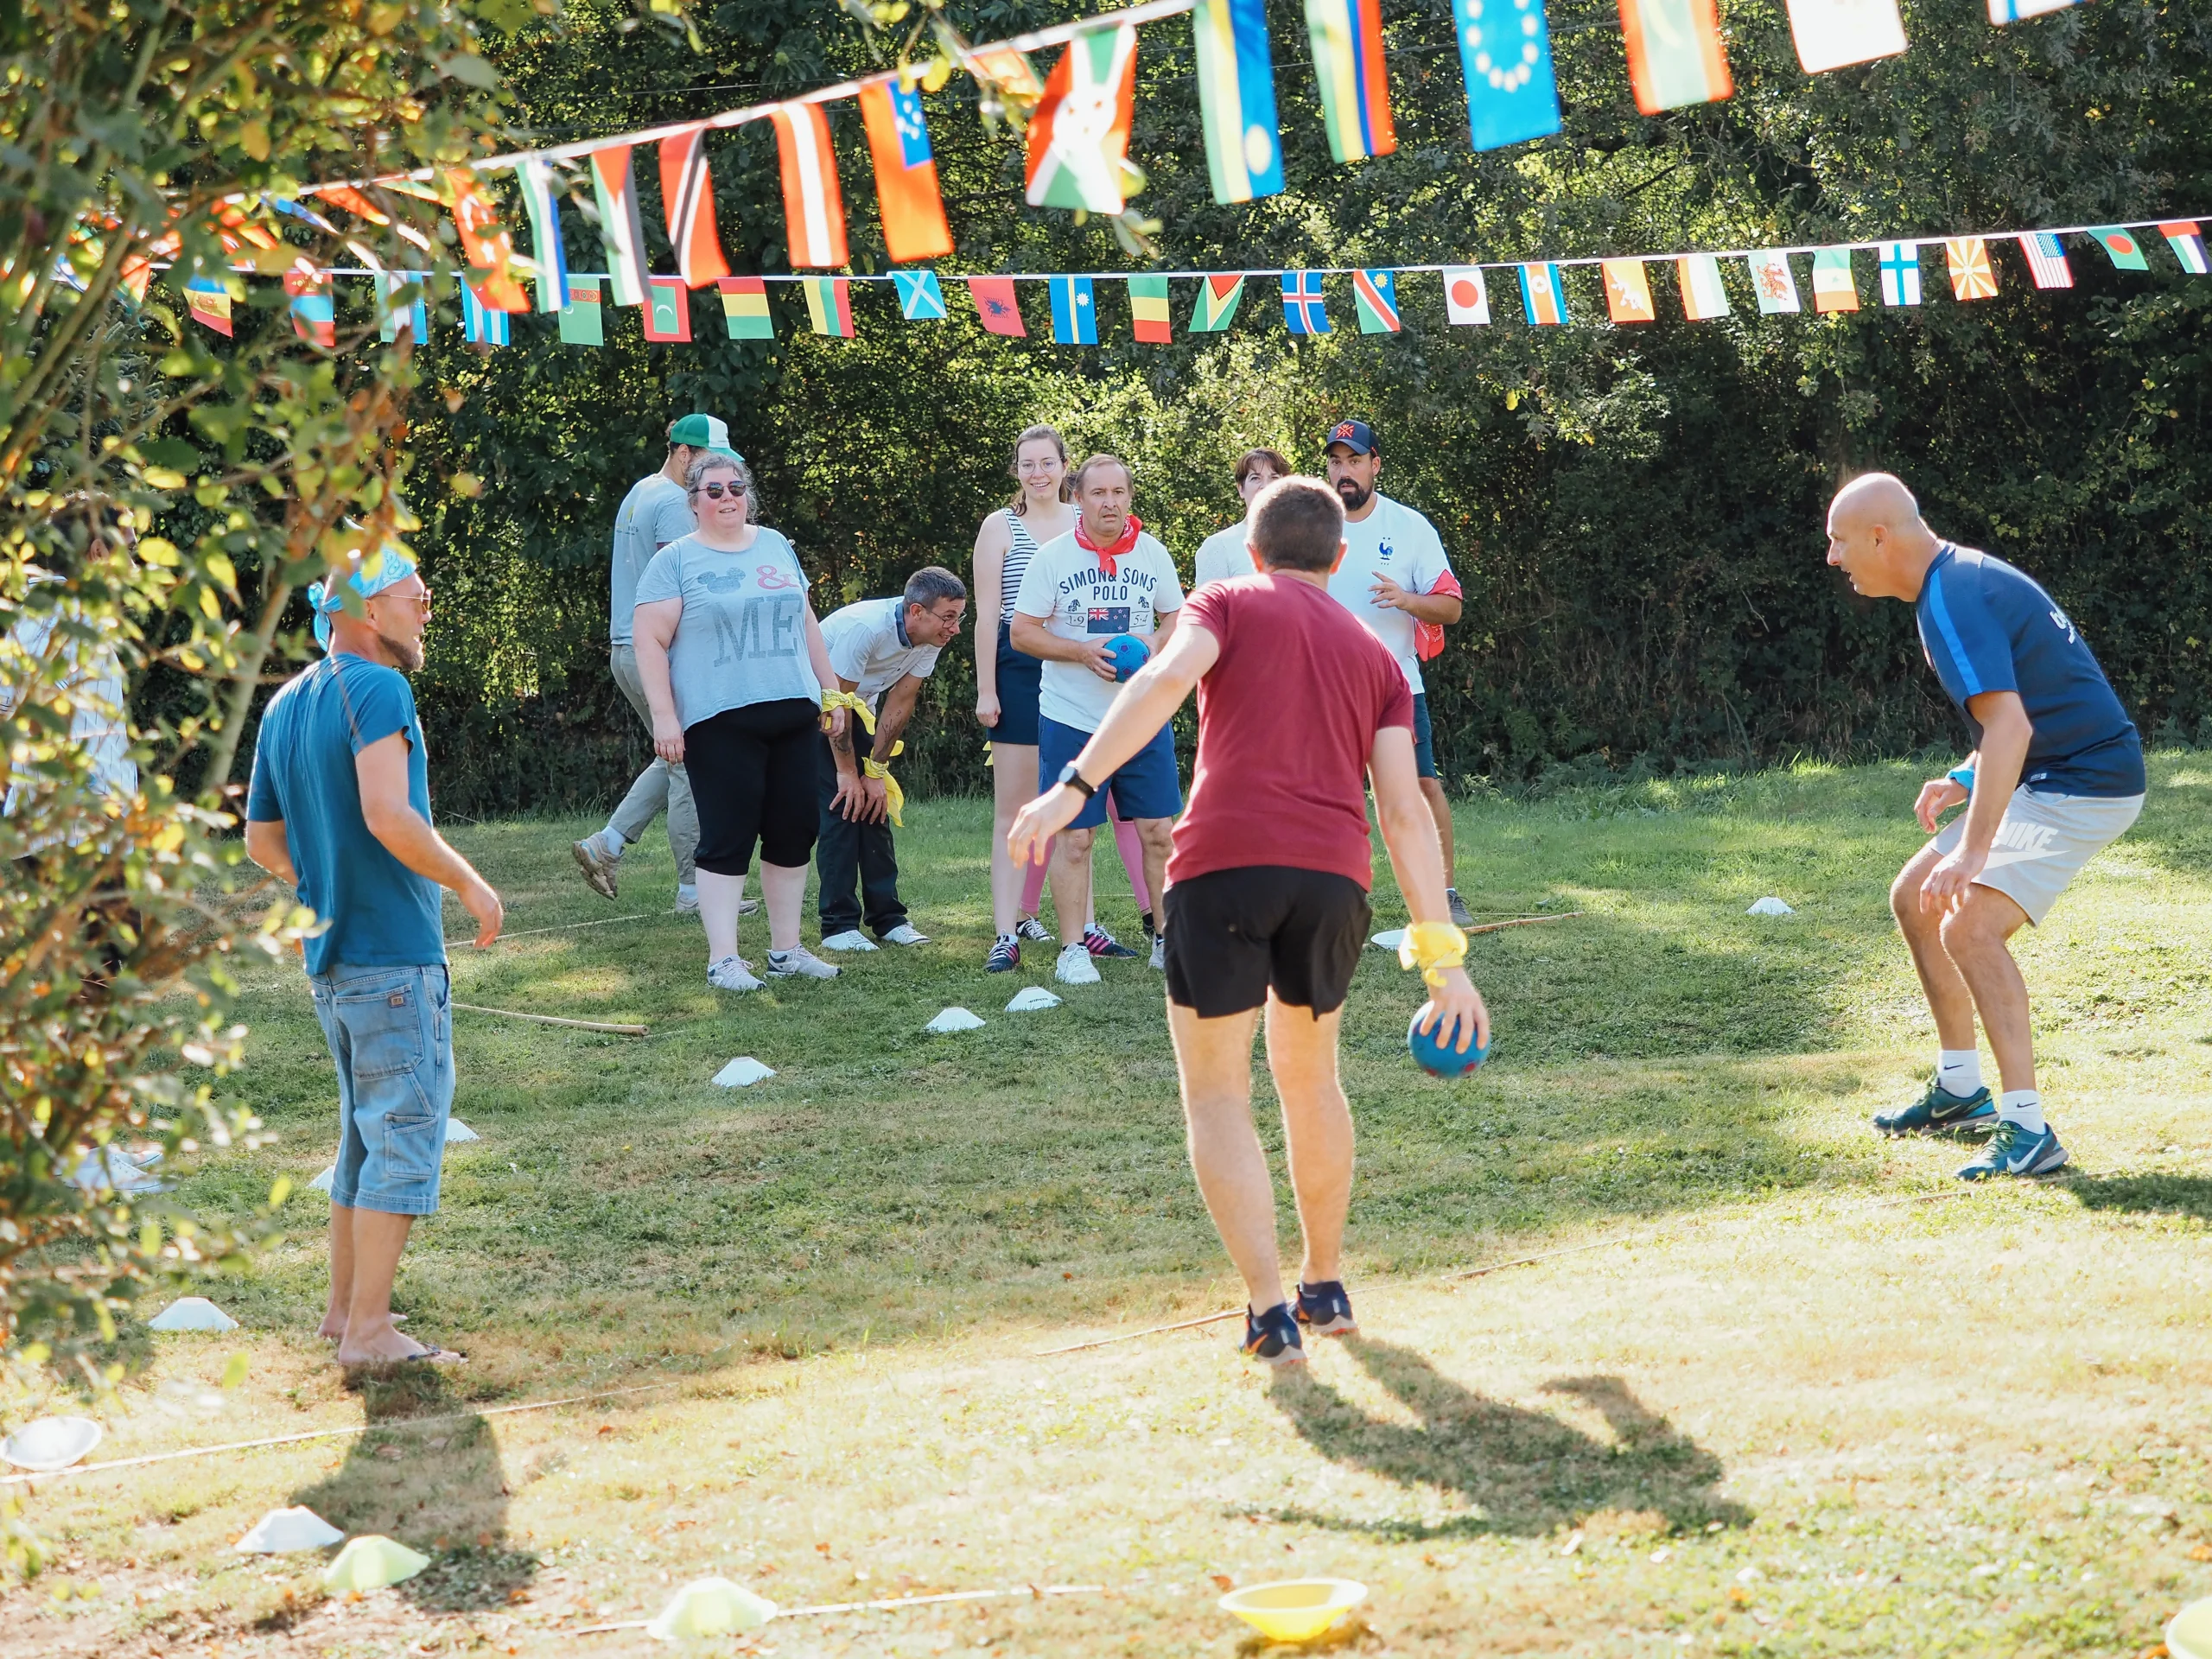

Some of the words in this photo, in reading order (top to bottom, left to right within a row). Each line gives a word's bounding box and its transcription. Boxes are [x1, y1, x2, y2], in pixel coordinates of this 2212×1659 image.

[756, 565, 799, 590] &
[1059, 568, 1107, 594] SIMON
[1122, 567, 1157, 592] SONS
[1093, 585, 1128, 601] POLO
[709, 593, 804, 668] ME
[1992, 822, 2060, 853] NIKE
